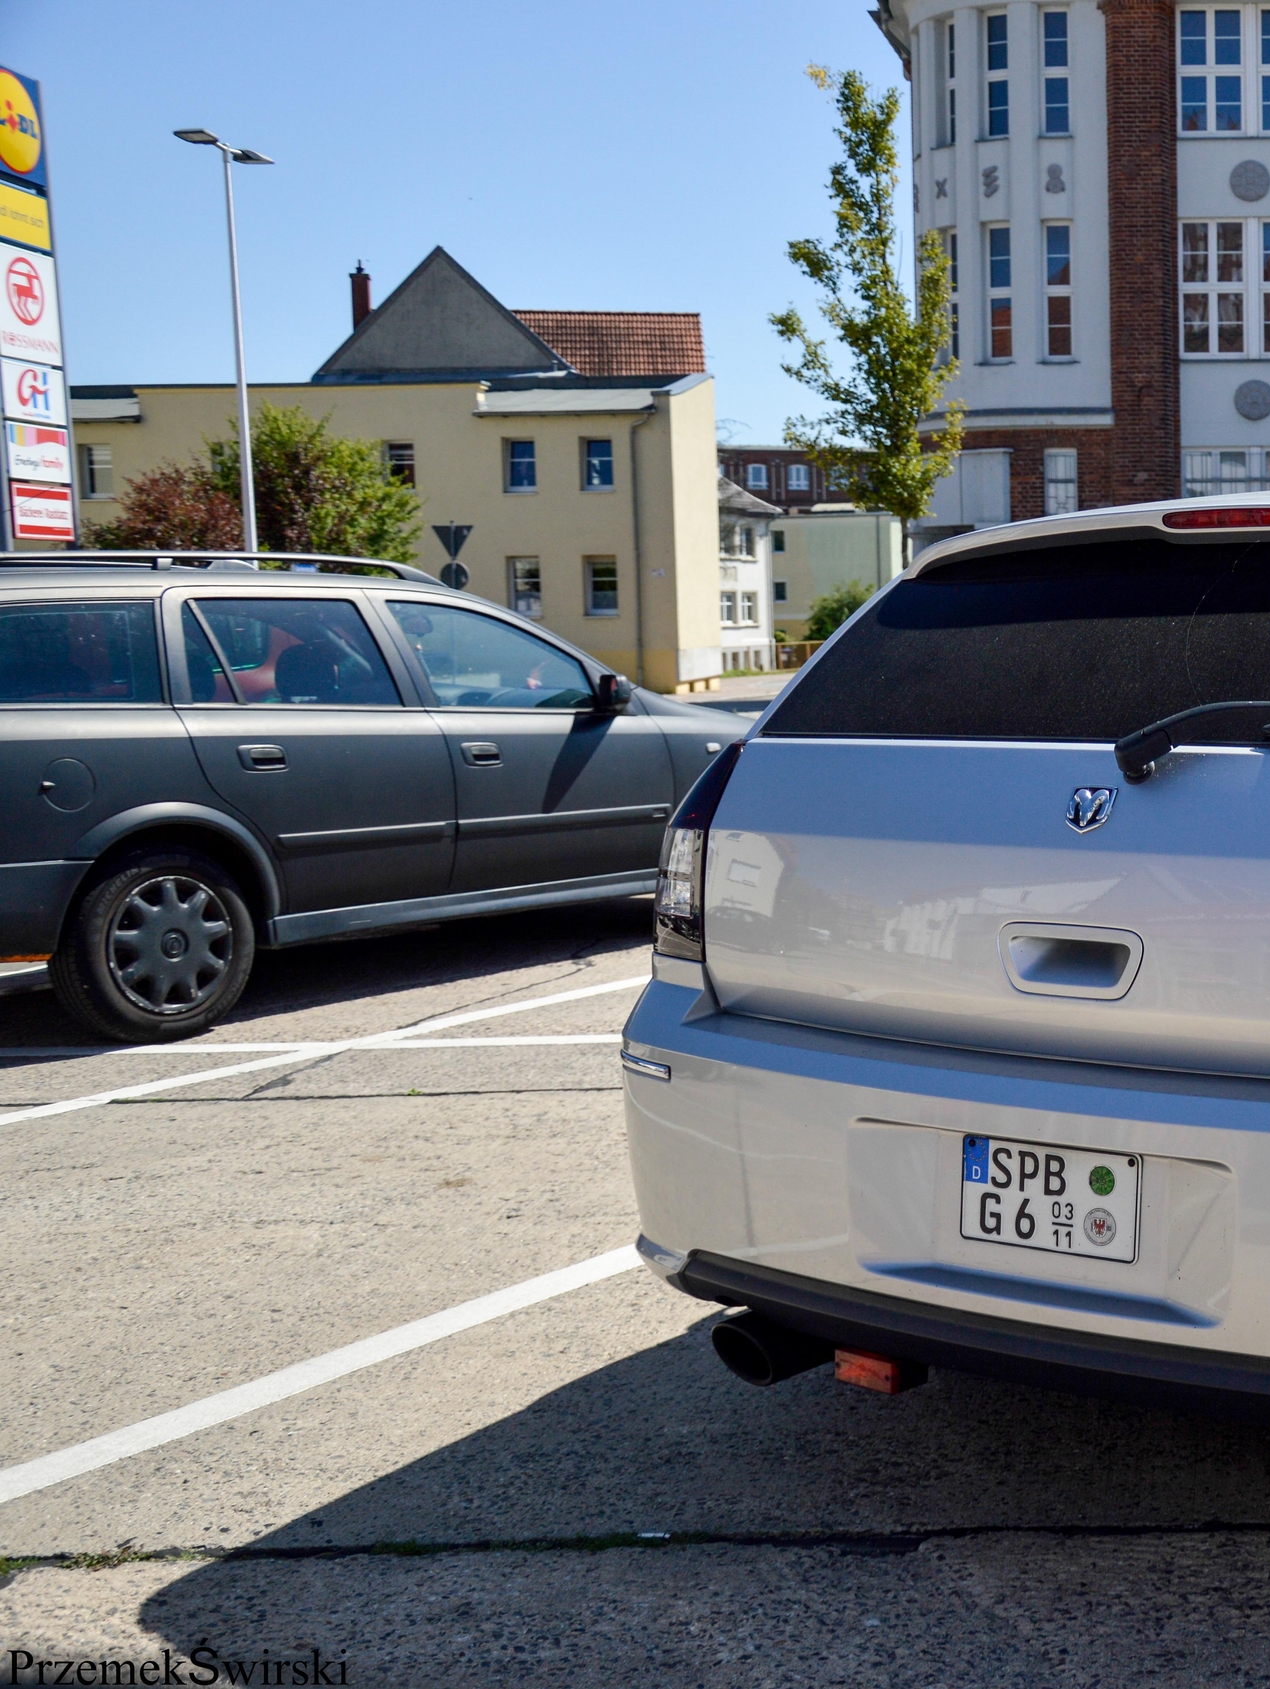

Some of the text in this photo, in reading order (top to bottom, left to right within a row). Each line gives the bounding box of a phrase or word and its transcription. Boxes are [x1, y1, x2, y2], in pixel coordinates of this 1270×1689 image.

[2, 330, 59, 354] ROSSMANN
[972, 1166, 981, 1180] D
[991, 1148, 1066, 1196] SPB
[1052, 1201, 1074, 1220] 03
[1052, 1229, 1072, 1249] 11
